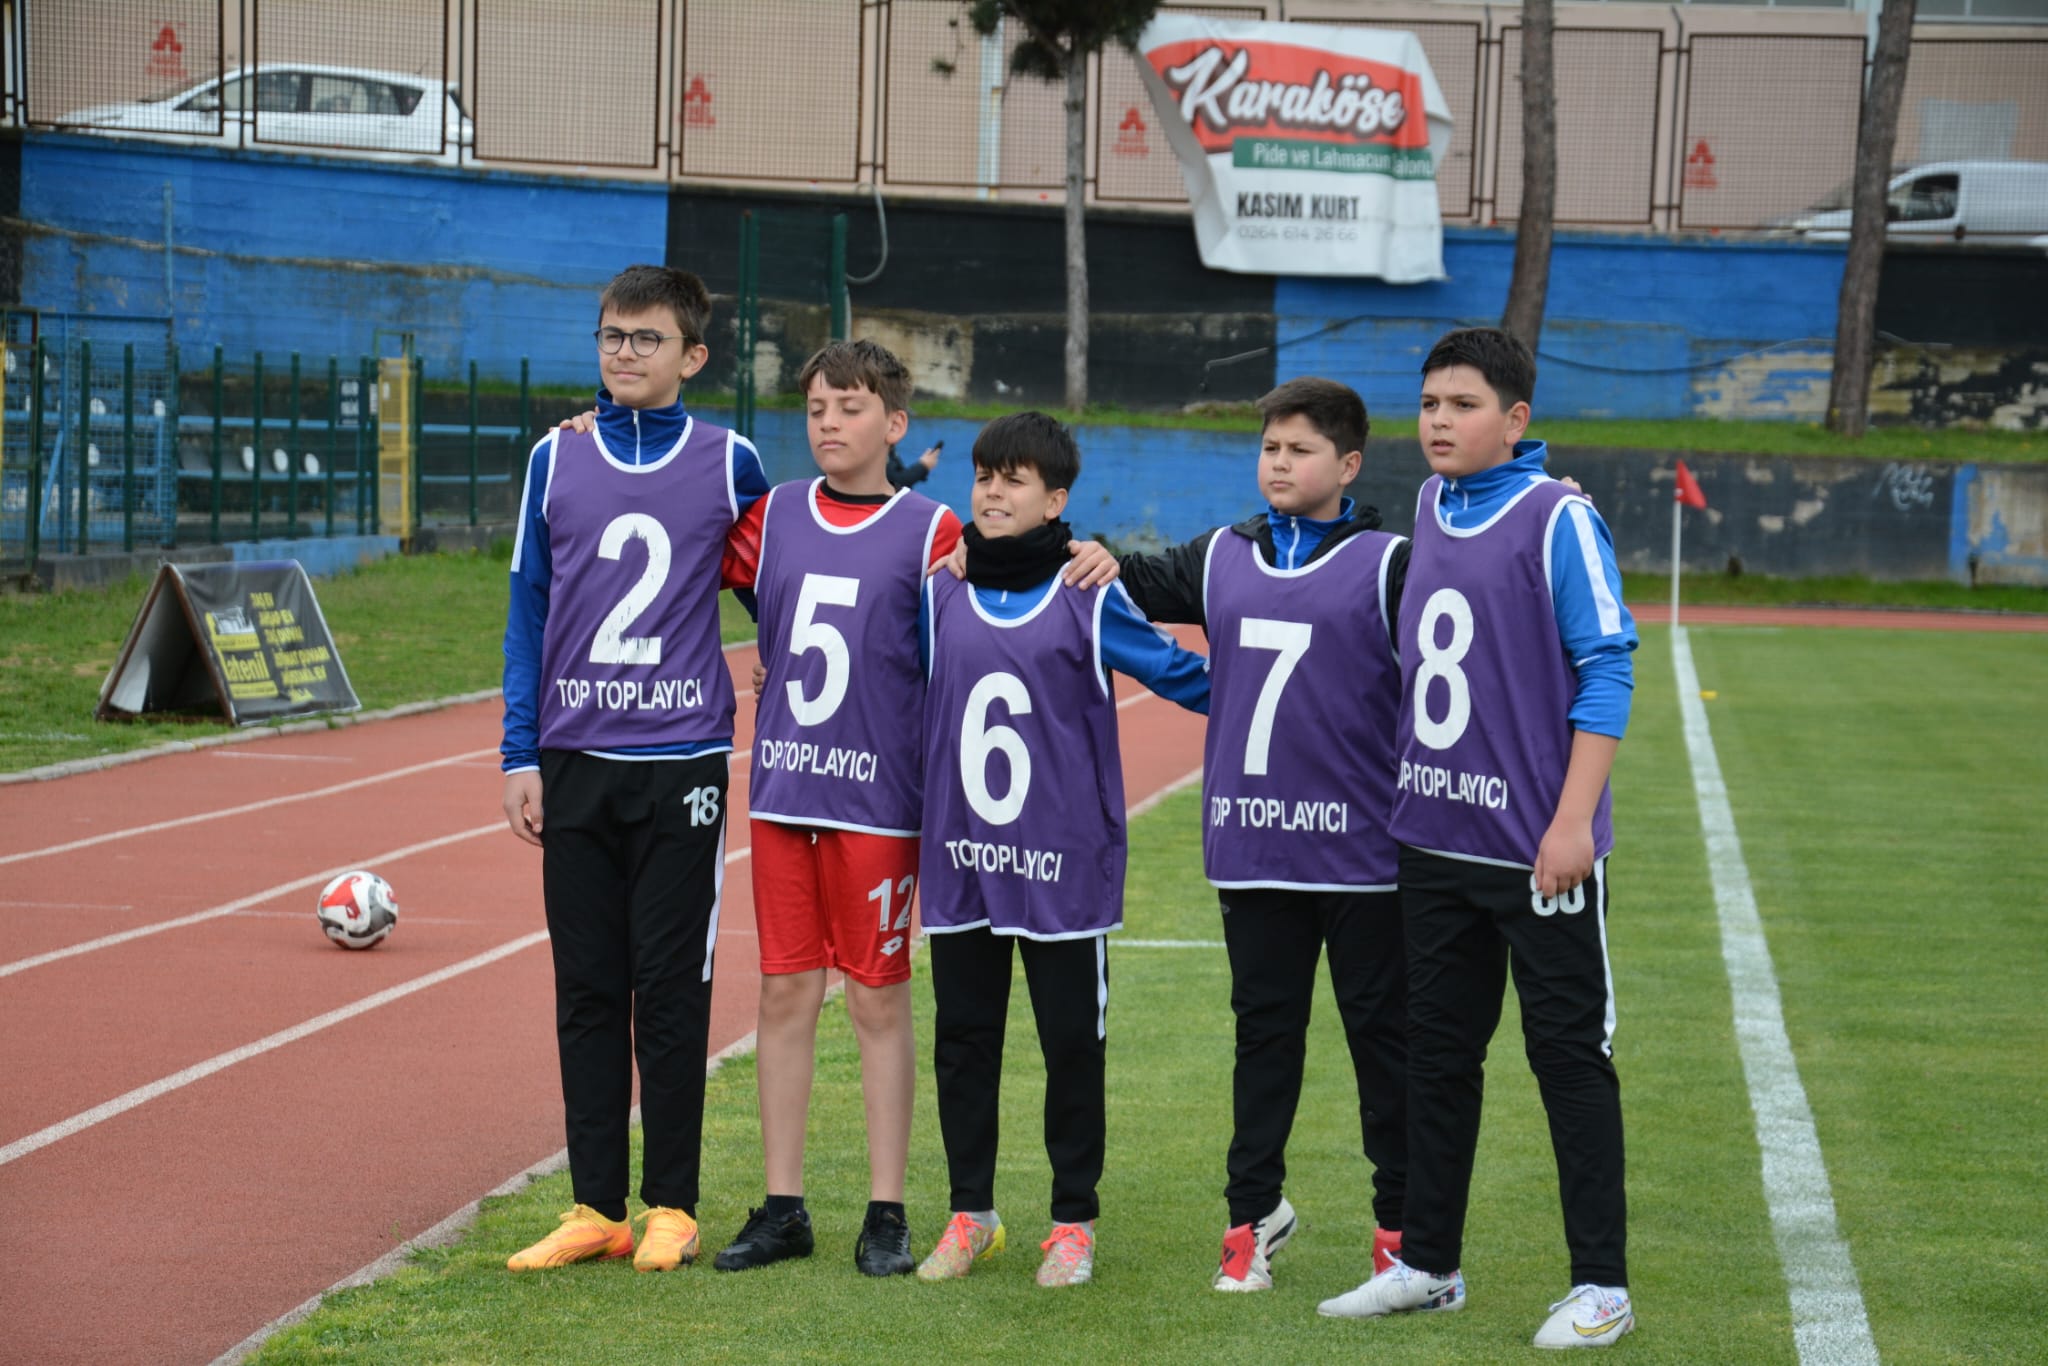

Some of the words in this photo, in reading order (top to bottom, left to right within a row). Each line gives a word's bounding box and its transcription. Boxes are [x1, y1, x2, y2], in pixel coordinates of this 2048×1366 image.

[1166, 46, 1405, 133] Karaköse
[1253, 142, 1287, 164] Pide
[1392, 153, 1435, 178] alonu
[1237, 192, 1303, 219] KASIM
[1311, 194, 1360, 220] KURT
[589, 512, 672, 665] 2
[785, 572, 860, 727] 5
[1413, 587, 1474, 750] 8
[556, 678, 591, 709] TOP
[596, 678, 703, 710] TOPLAYICI
[1239, 617, 1313, 776] 7
[960, 671, 1032, 826] 6
[683, 785, 720, 827] 18
[1236, 797, 1348, 833] TOPLAYICI
[868, 874, 914, 932] 12
